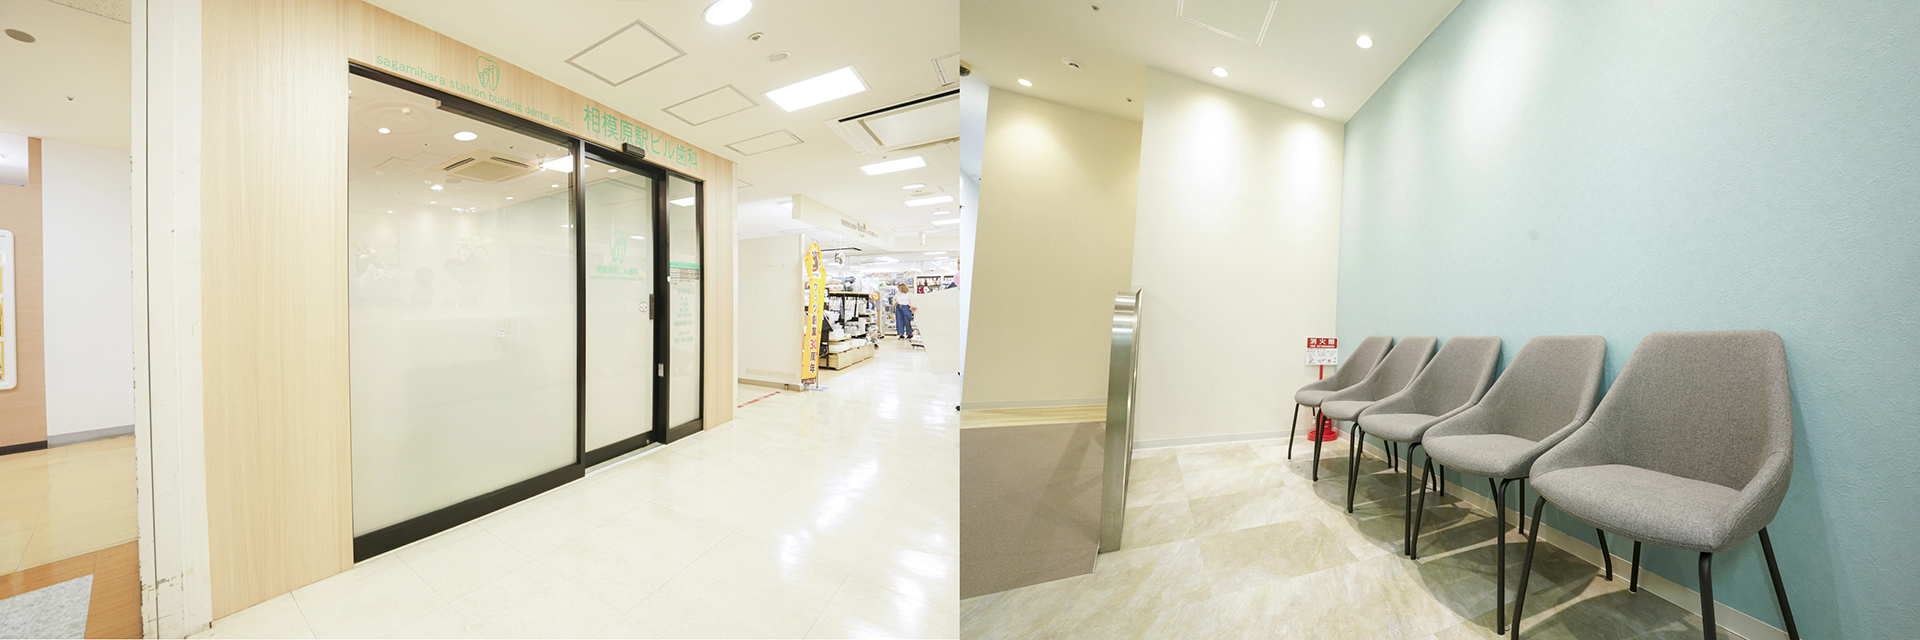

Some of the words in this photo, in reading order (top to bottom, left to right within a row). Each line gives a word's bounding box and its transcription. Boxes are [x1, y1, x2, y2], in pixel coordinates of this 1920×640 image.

[376, 55, 446, 86] sagamihara
[449, 80, 486, 99] station
[488, 92, 523, 113] building
[524, 106, 550, 121] dental
[551, 116, 571, 129] clinic
[583, 104, 698, 171] 相模原駅ビル歯科
